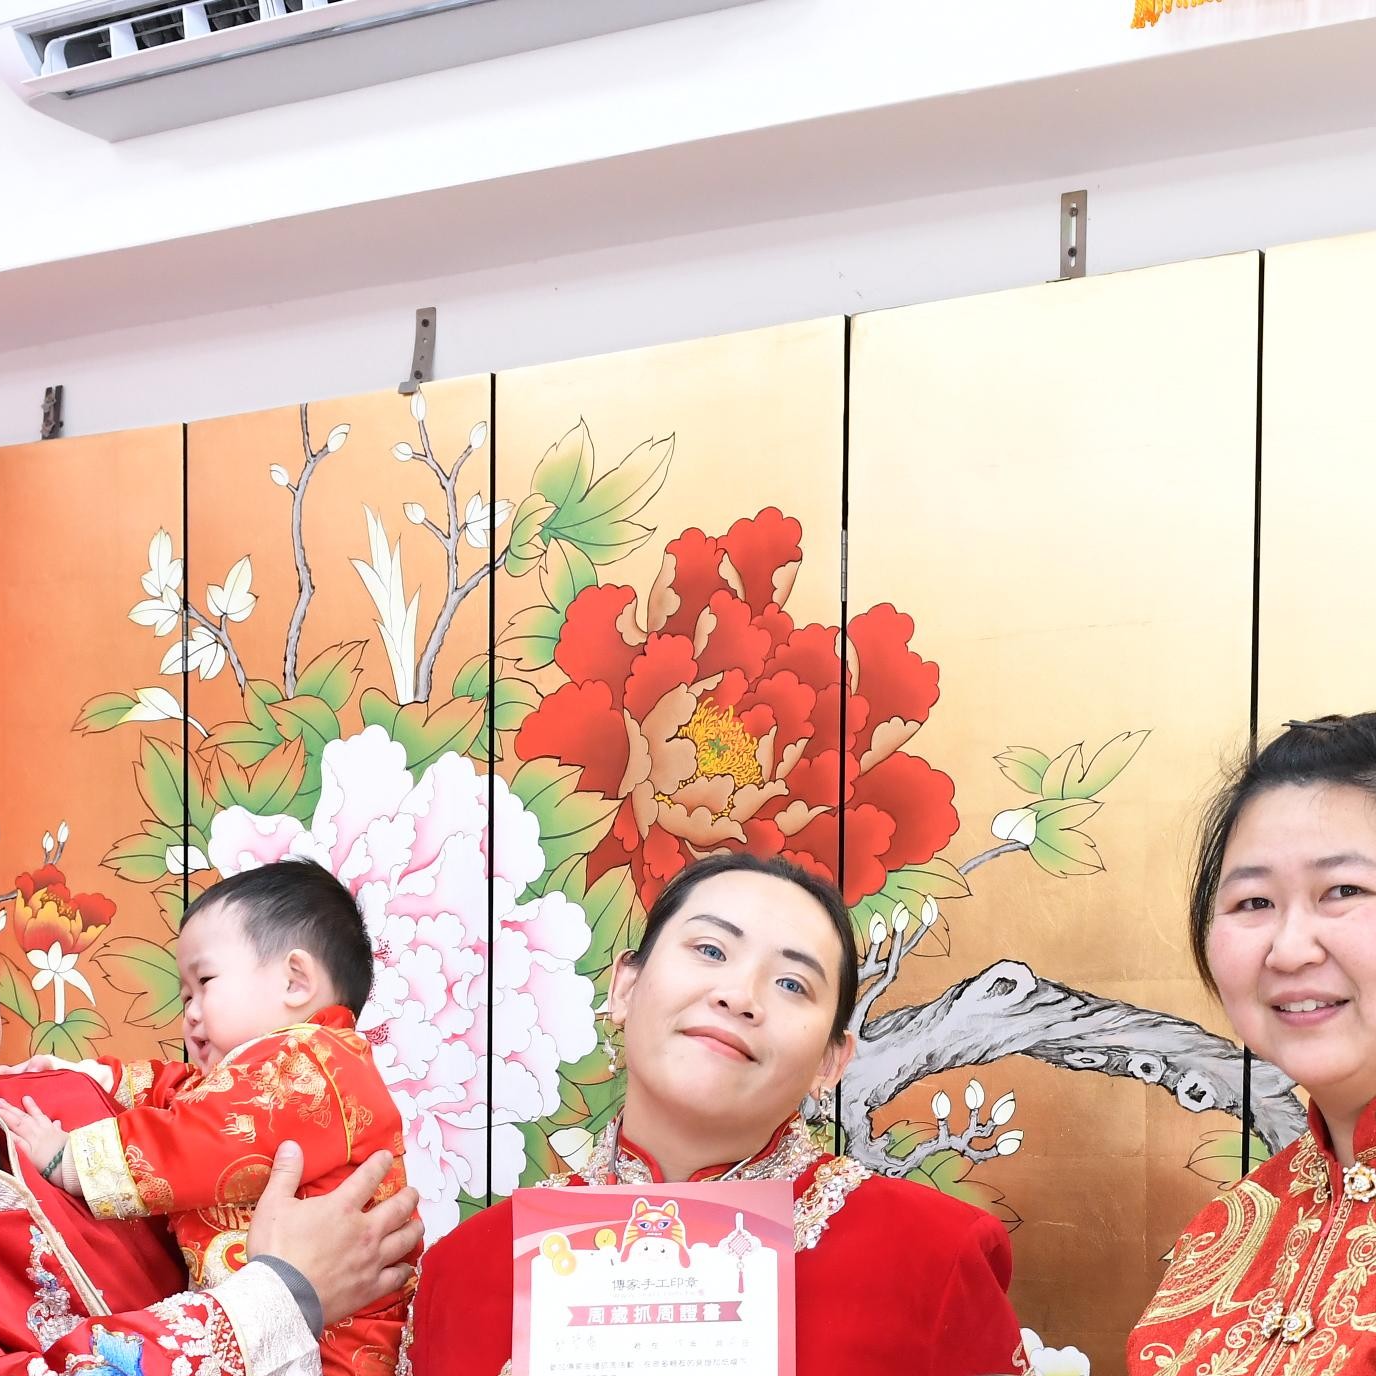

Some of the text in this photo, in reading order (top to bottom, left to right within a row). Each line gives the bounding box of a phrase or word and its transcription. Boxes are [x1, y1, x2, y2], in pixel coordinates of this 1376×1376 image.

[611, 1276, 699, 1291] 傳家手工印章
